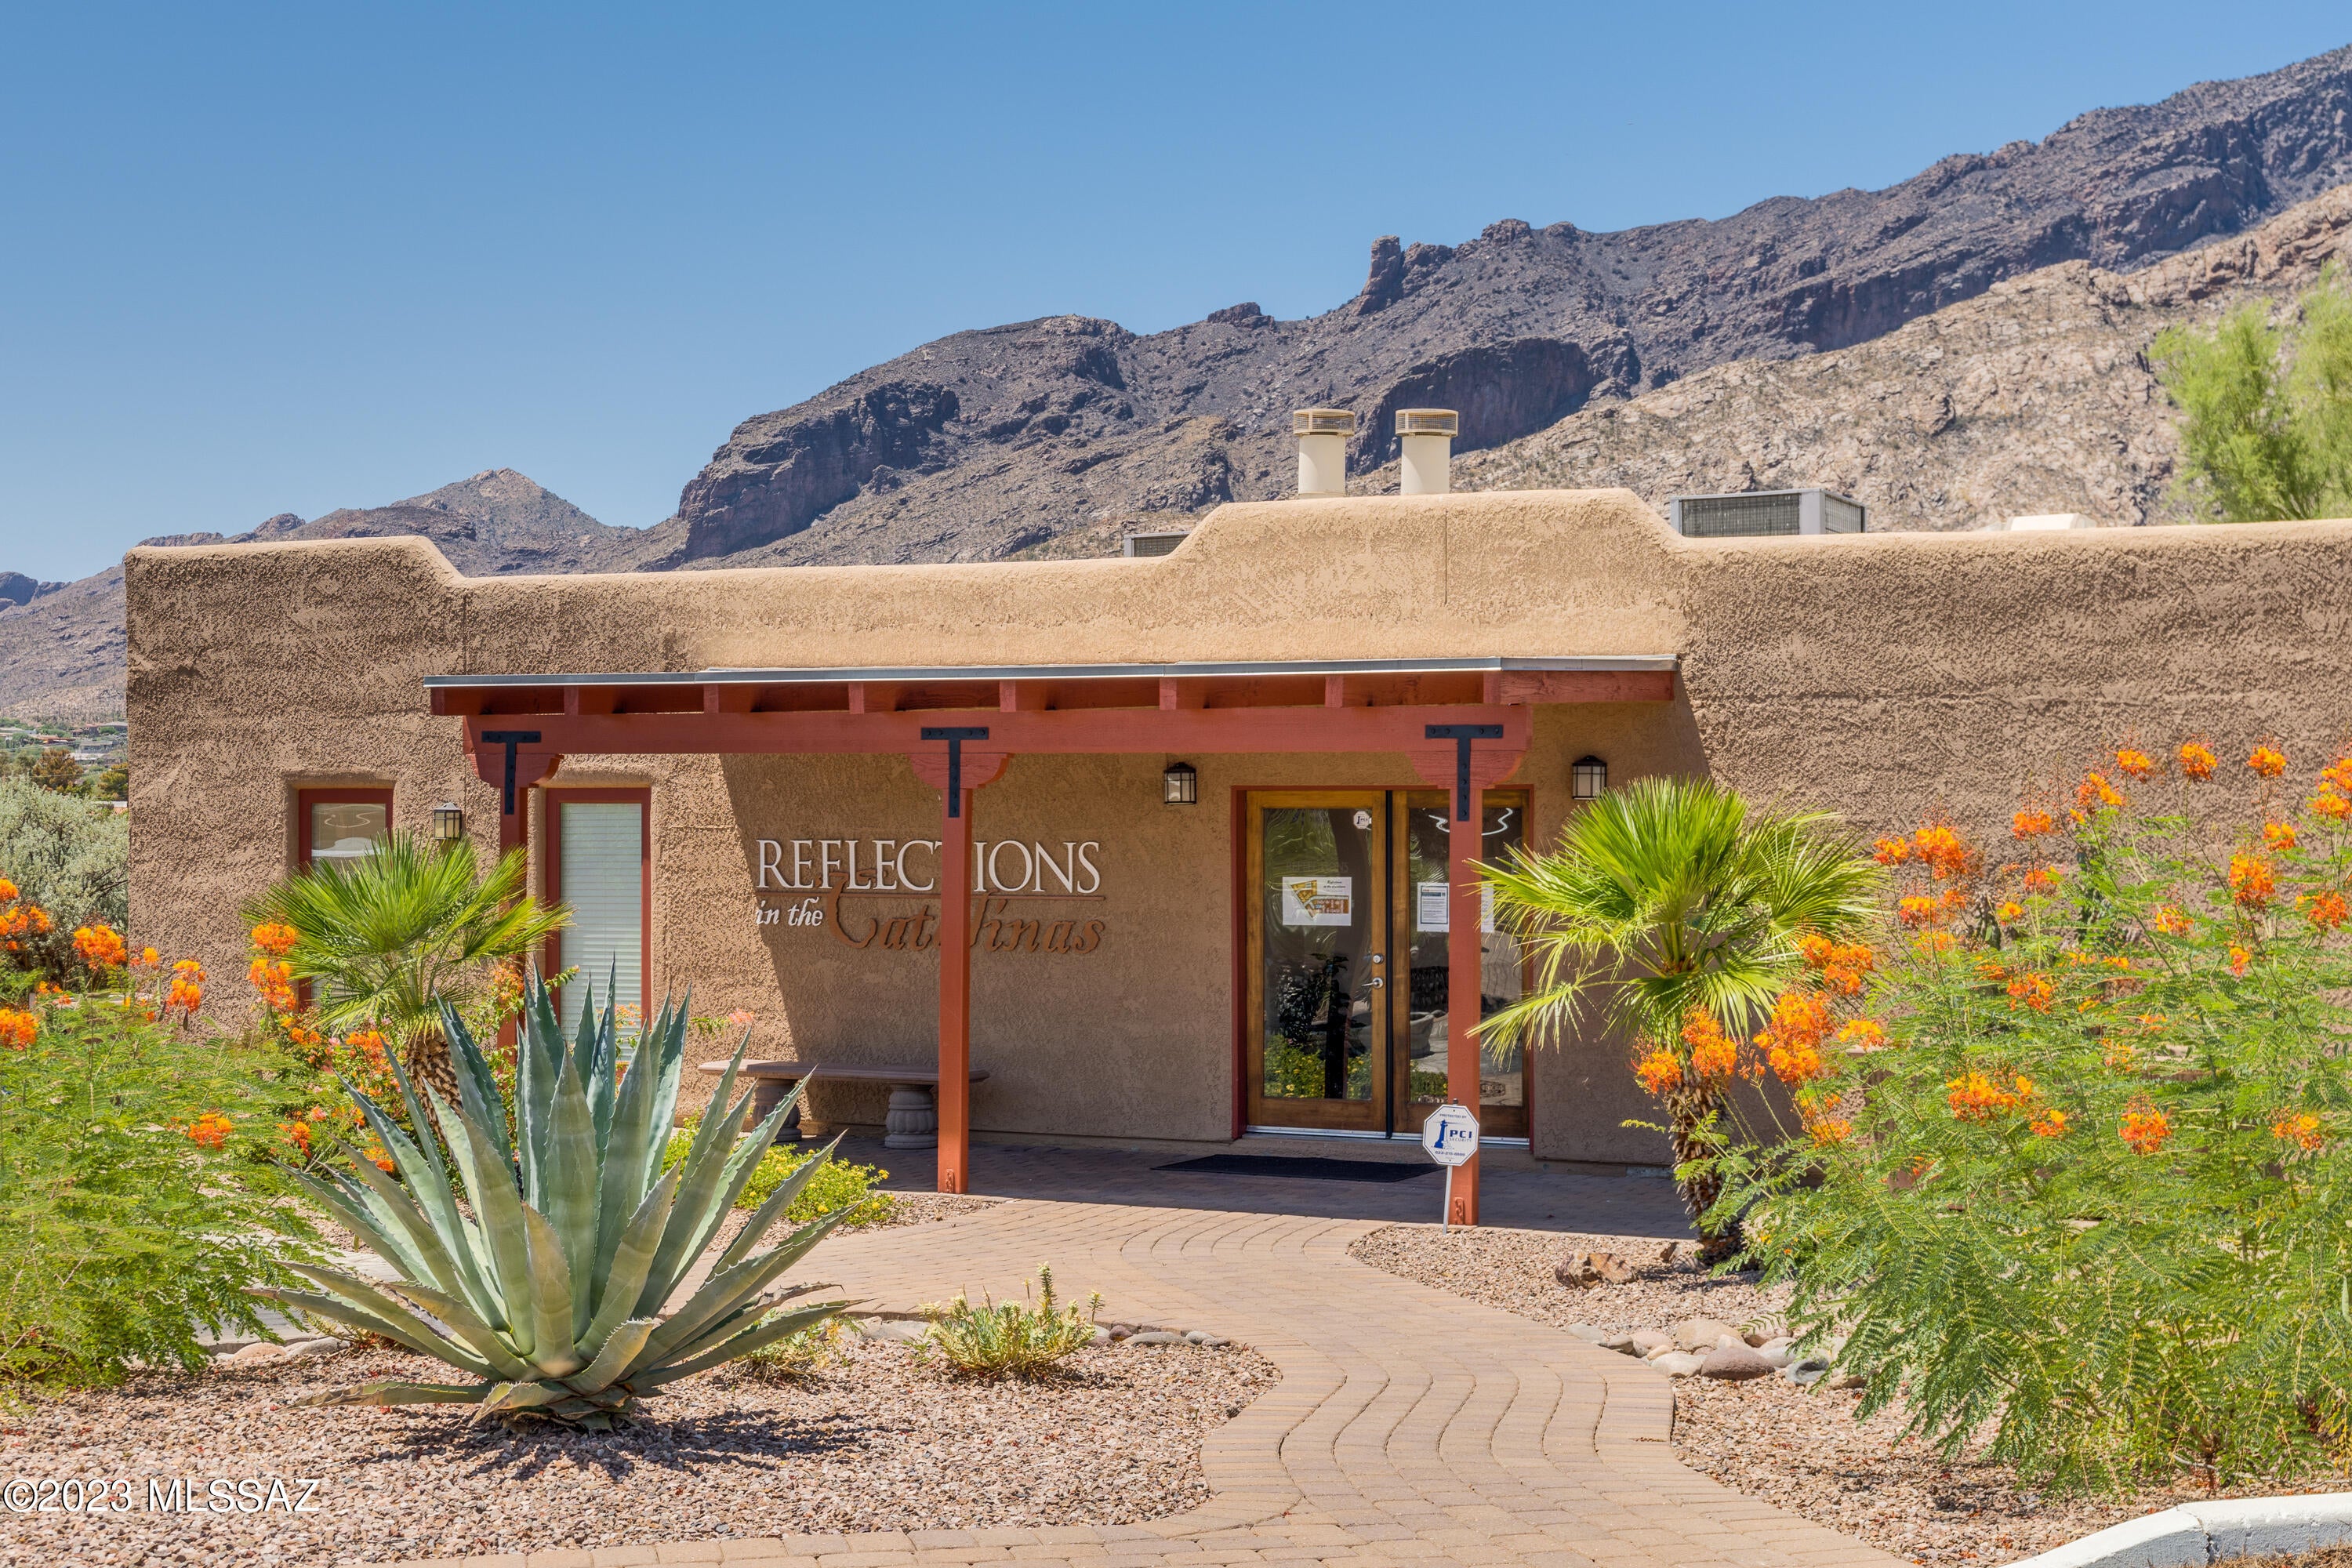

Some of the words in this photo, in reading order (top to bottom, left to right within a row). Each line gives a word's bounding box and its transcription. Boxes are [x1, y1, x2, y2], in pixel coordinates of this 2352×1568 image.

[755, 839, 1101, 894] REFLECIONS
[756, 900, 779, 925] in
[787, 896, 824, 927] the
[815, 869, 1105, 955] Catlinas
[1450, 1130, 1472, 1138] PCI
